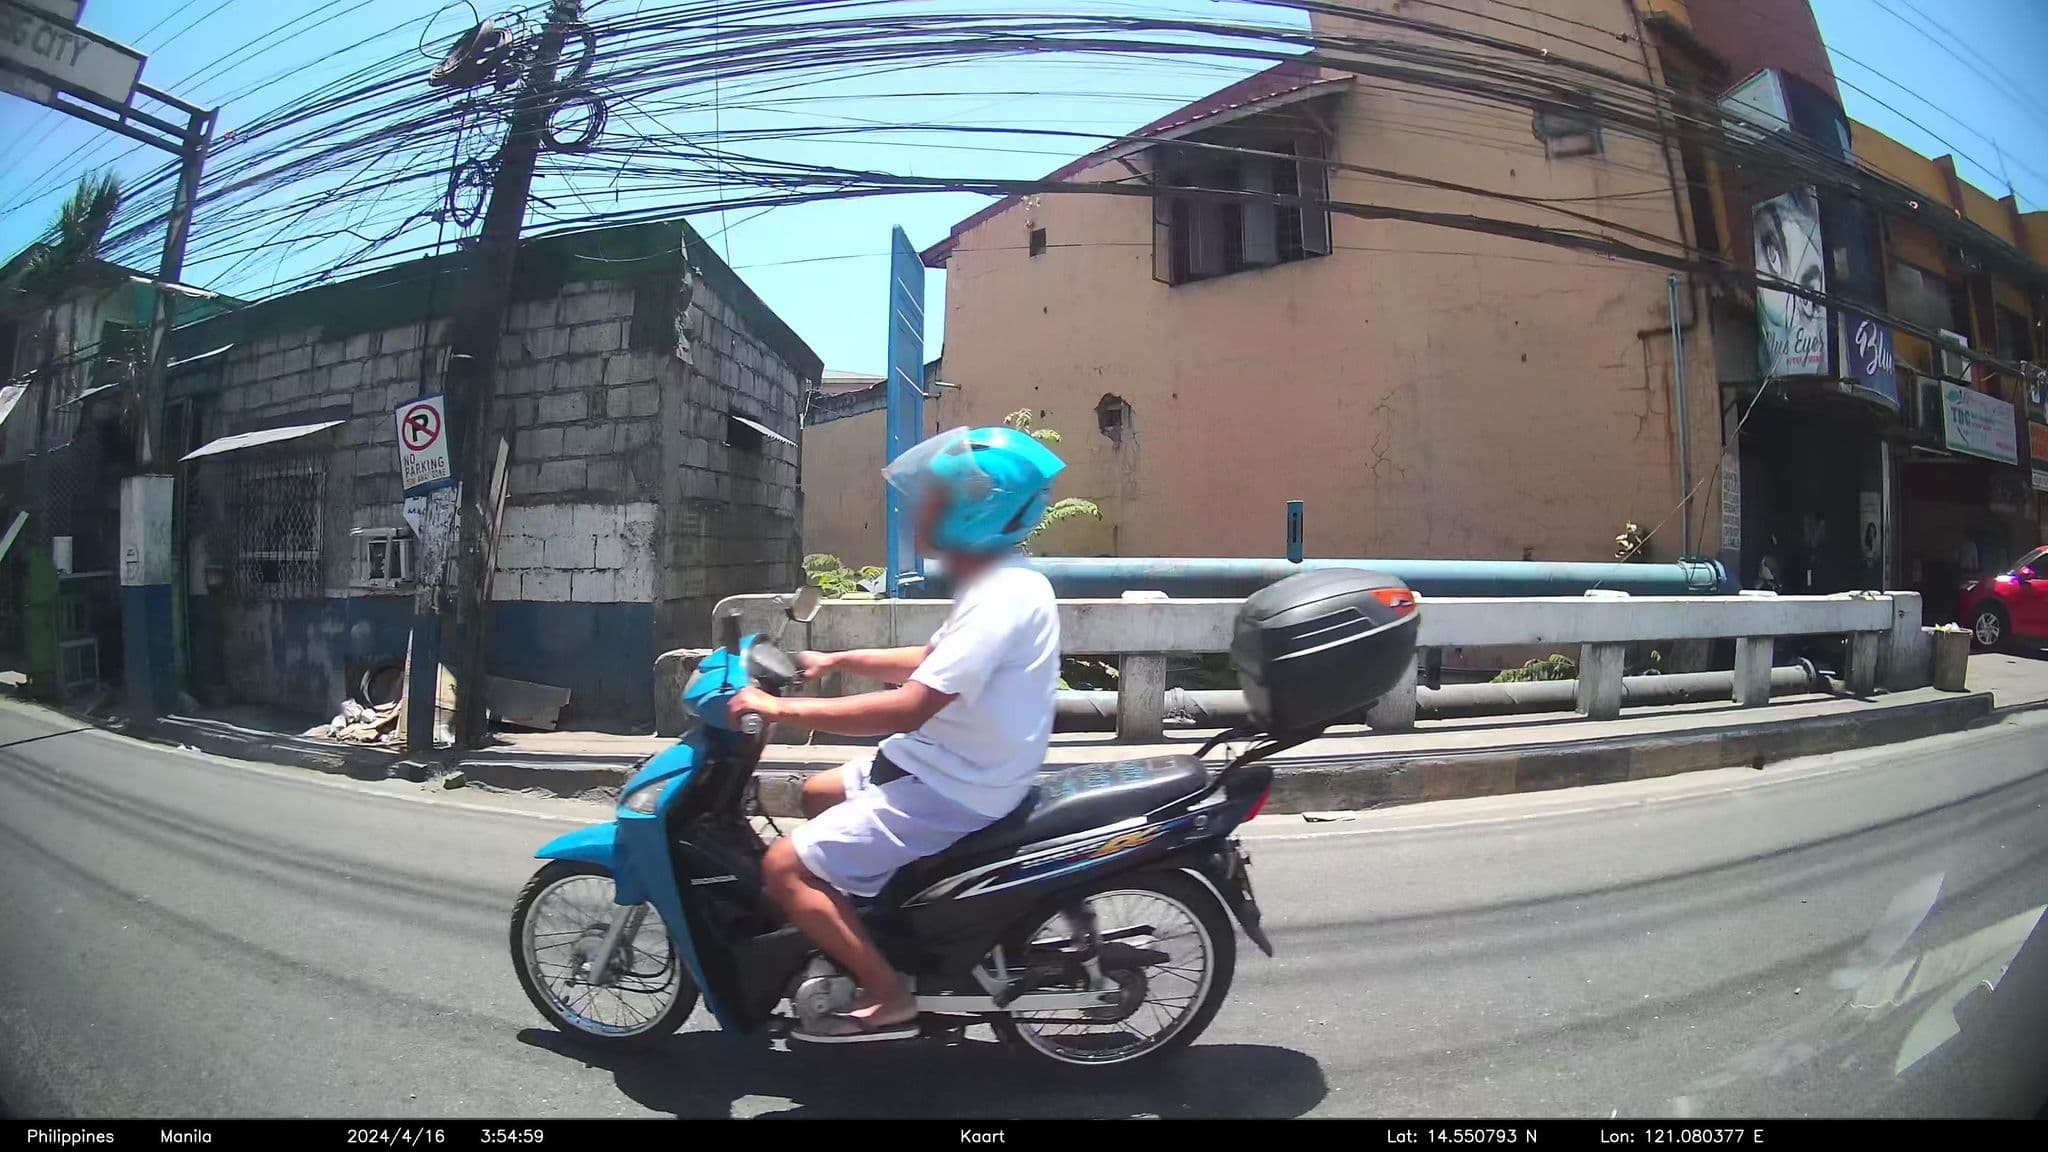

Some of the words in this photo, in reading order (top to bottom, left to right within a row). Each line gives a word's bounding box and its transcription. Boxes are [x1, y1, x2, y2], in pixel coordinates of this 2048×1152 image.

[33, 23, 92, 67] CITY
[1794, 327, 1824, 367] Eyes
[404, 453, 416, 466] NO
[405, 456, 445, 479] PARKING
